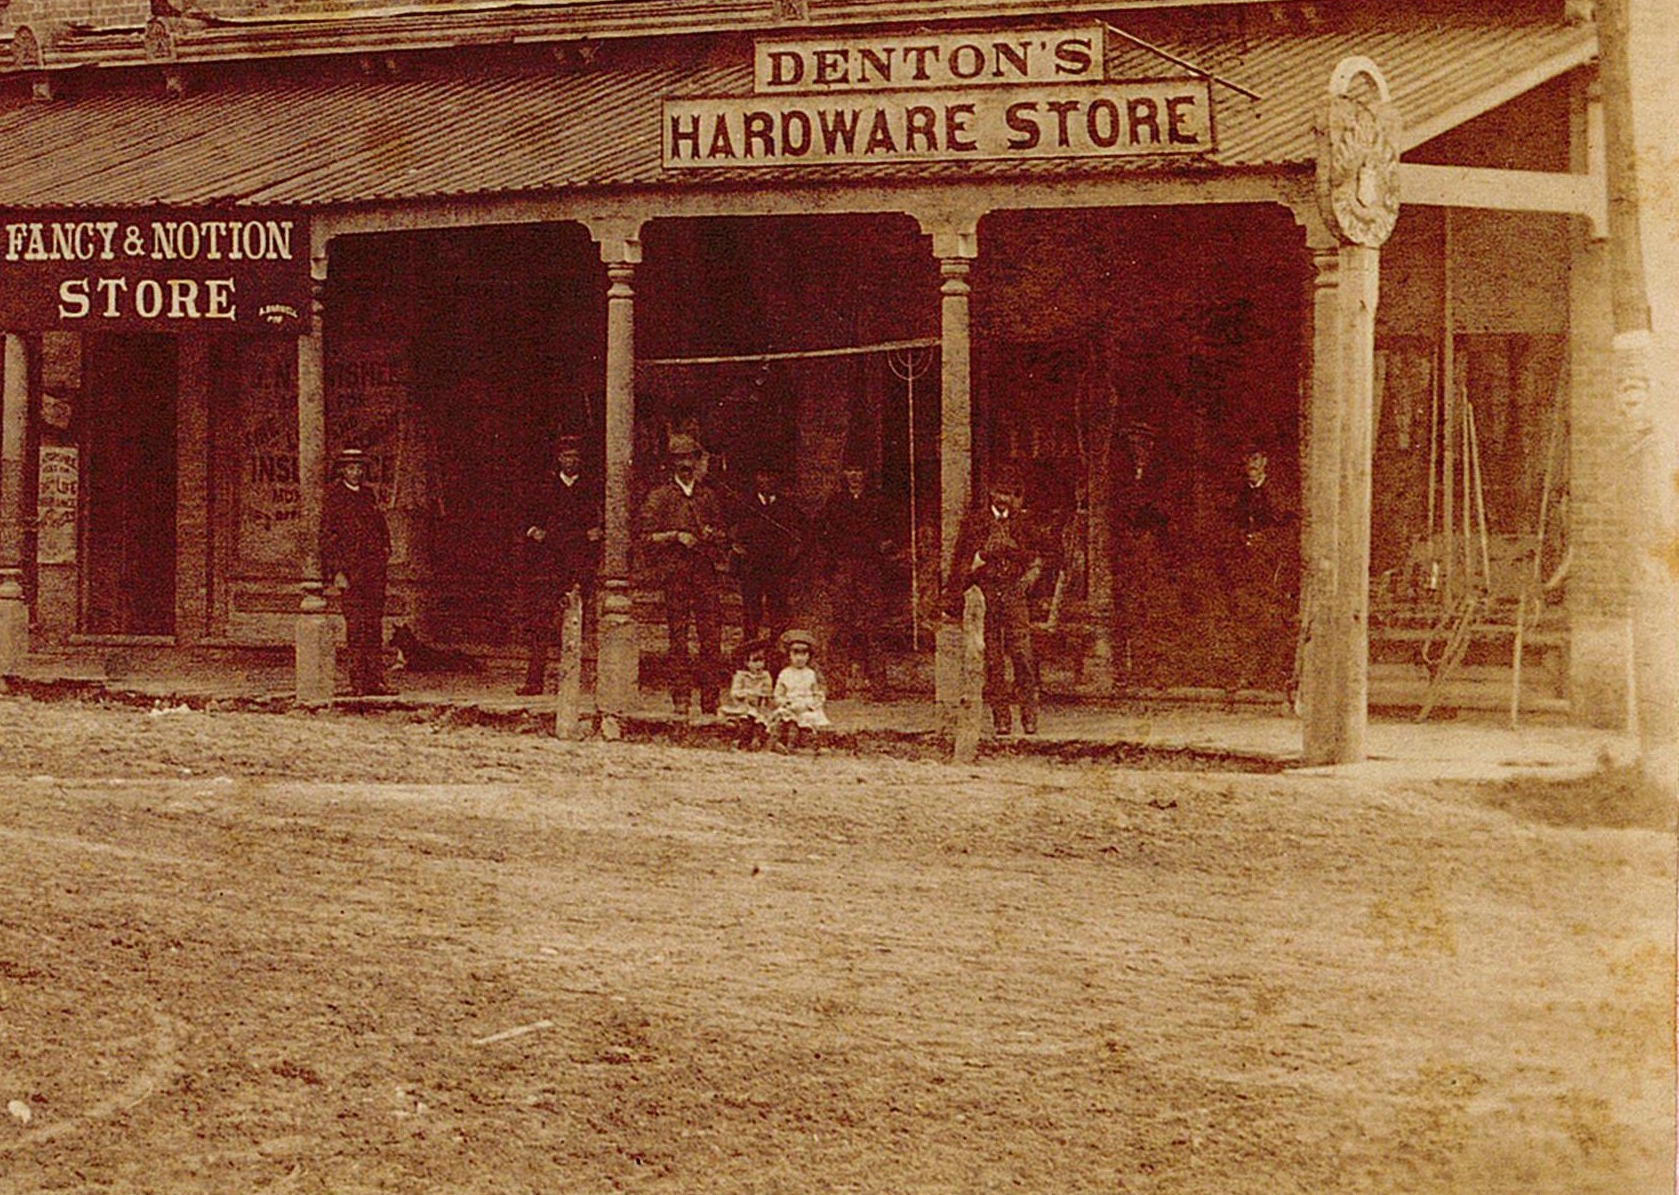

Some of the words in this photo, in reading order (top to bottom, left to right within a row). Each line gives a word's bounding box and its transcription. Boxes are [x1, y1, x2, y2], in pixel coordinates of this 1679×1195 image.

[766, 37, 1094, 89] DENTON'S
[669, 102, 978, 161] HARDWARE
[1005, 94, 1201, 152] STORE
[5, 221, 119, 261] FANCY
[123, 225, 146, 256] &
[150, 220, 294, 261] NOTION
[58, 276, 237, 322] STORE
